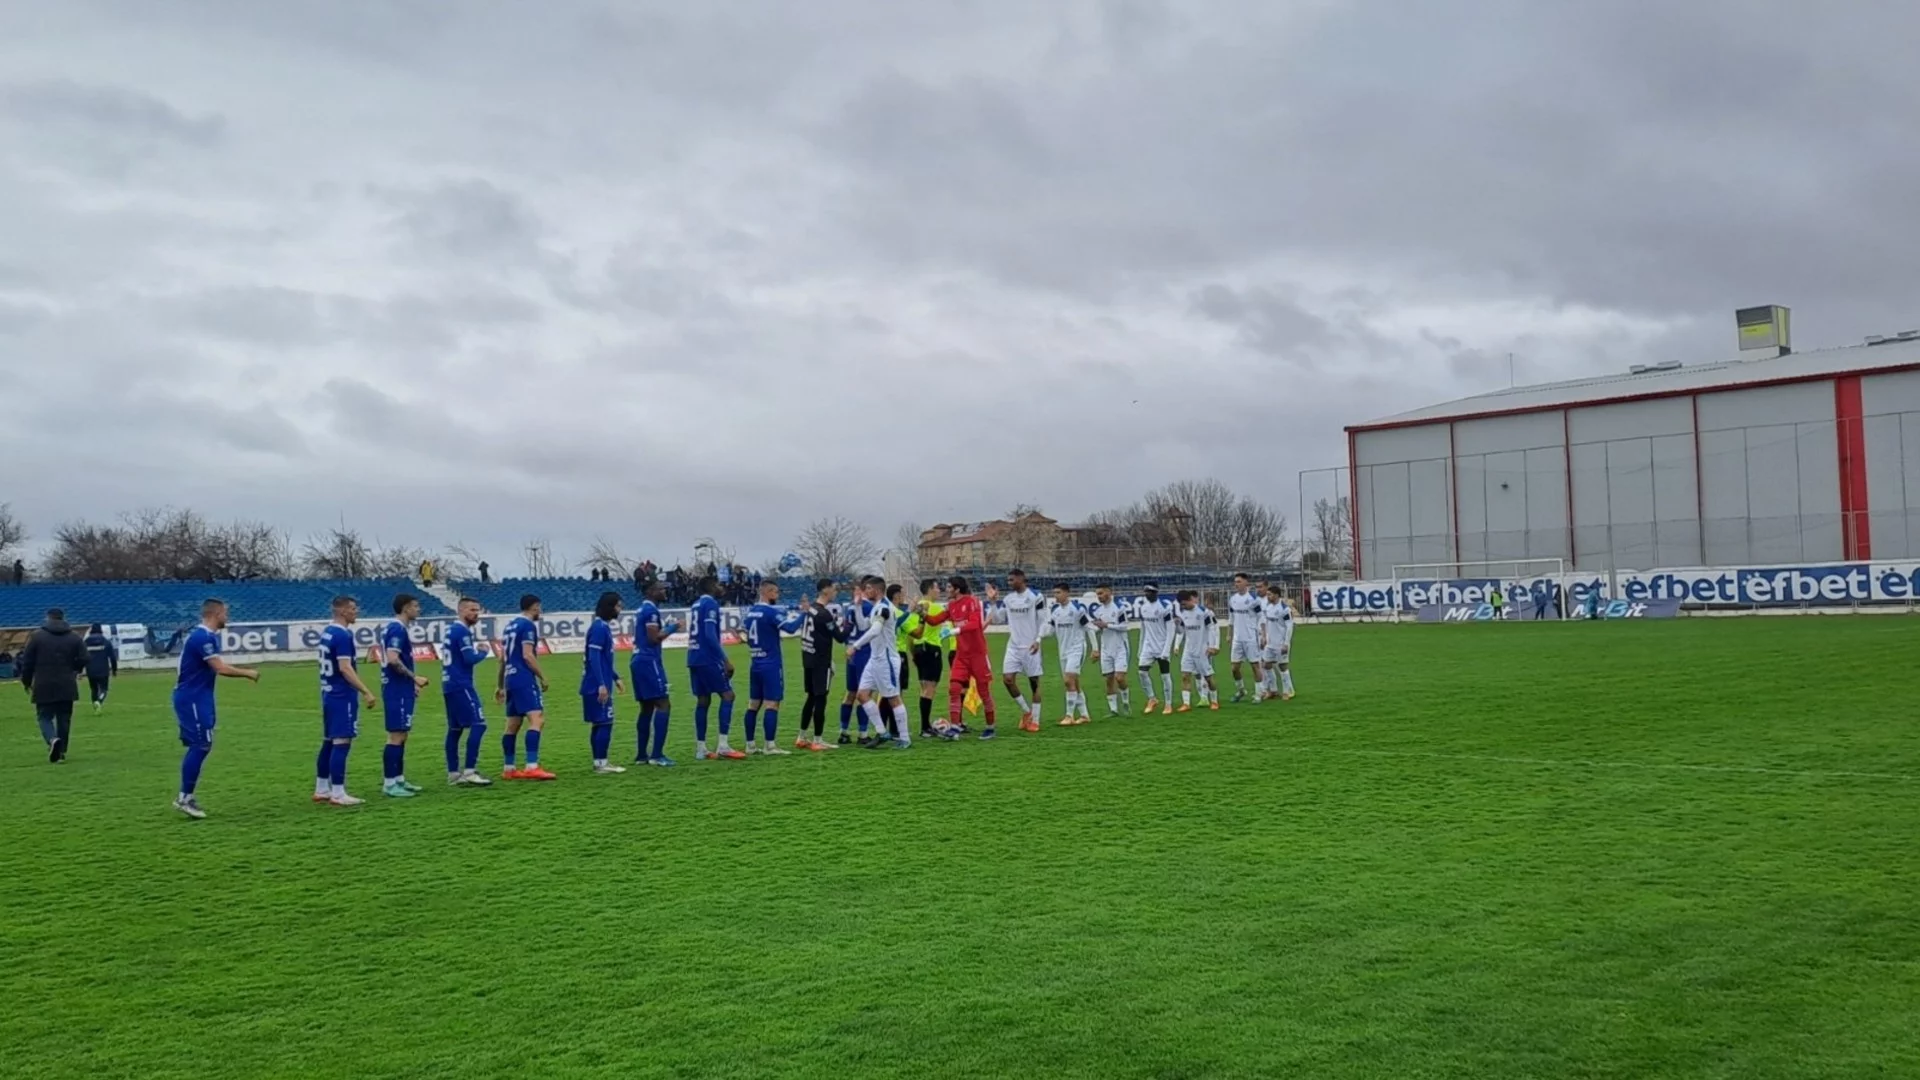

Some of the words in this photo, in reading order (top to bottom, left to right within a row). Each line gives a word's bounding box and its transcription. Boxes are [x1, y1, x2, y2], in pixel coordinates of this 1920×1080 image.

[1625, 574, 1736, 601] efbet
[1746, 568, 1868, 600] efbet
[1317, 585, 1394, 610] efbet
[749, 619, 759, 645] 4
[802, 617, 815, 642] 12
